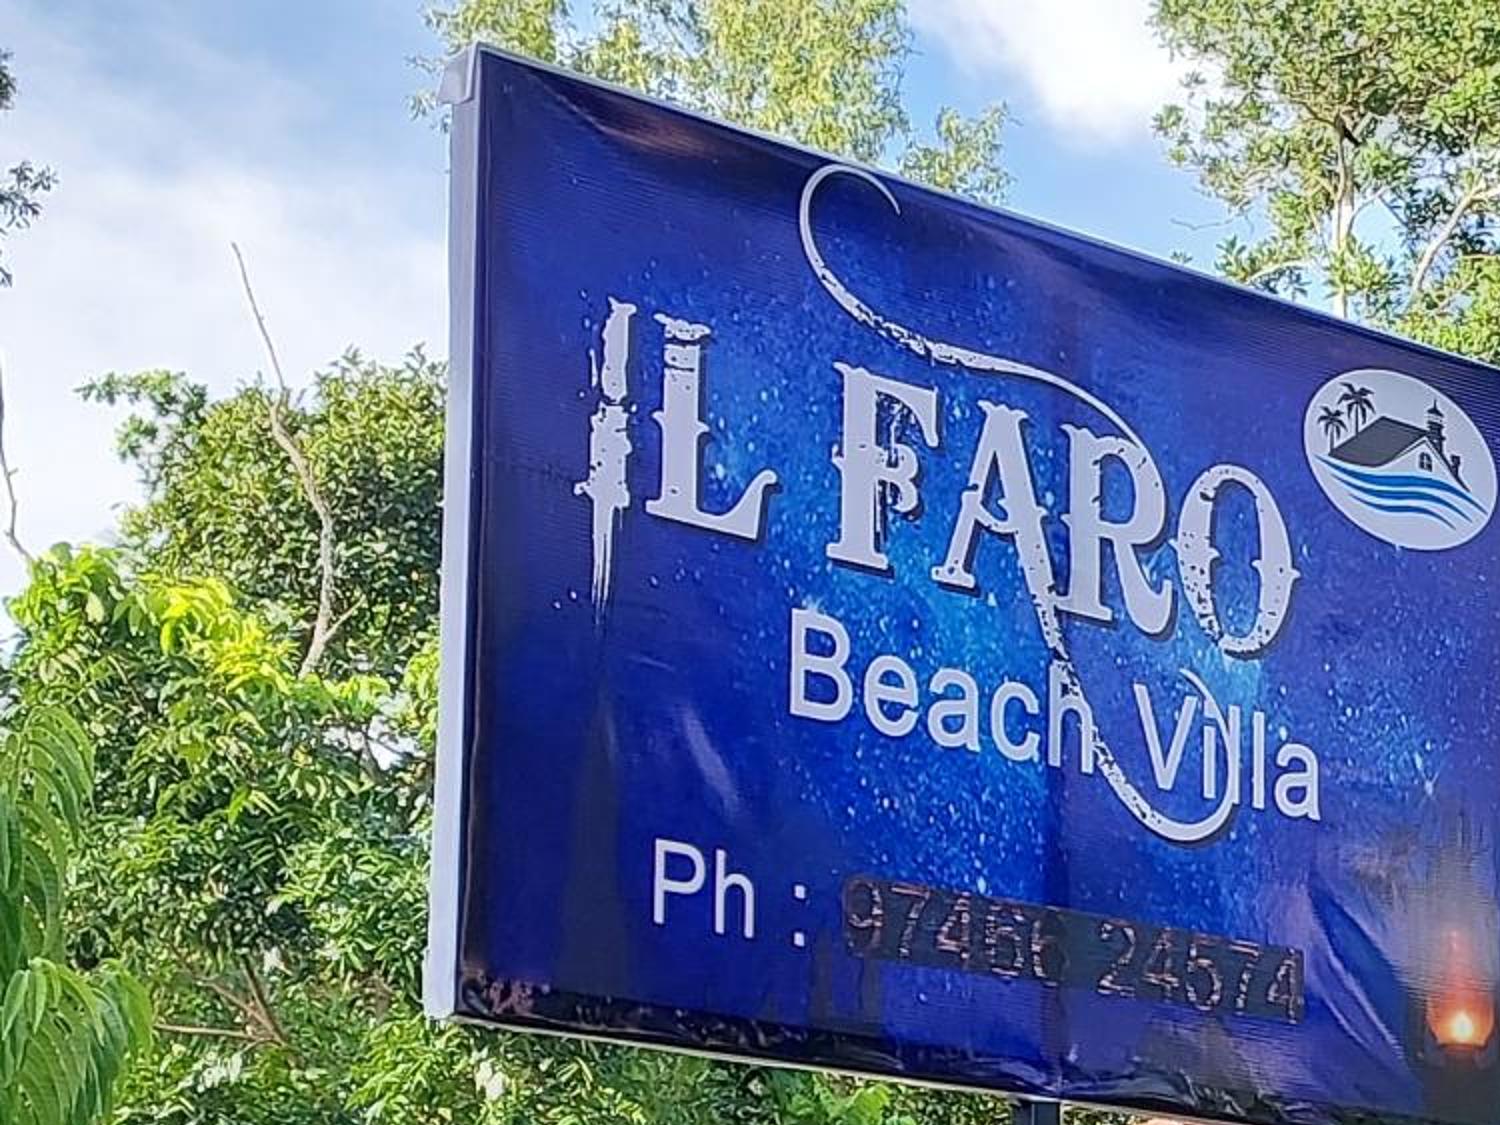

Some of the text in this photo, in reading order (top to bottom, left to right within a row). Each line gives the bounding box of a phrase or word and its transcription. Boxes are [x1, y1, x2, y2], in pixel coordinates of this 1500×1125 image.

[574, 297, 1300, 656] IL FARO
[789, 607, 1321, 822] Beach Villa
[652, 837, 756, 940] Ph
[1097, 917, 1304, 1025] 24574
